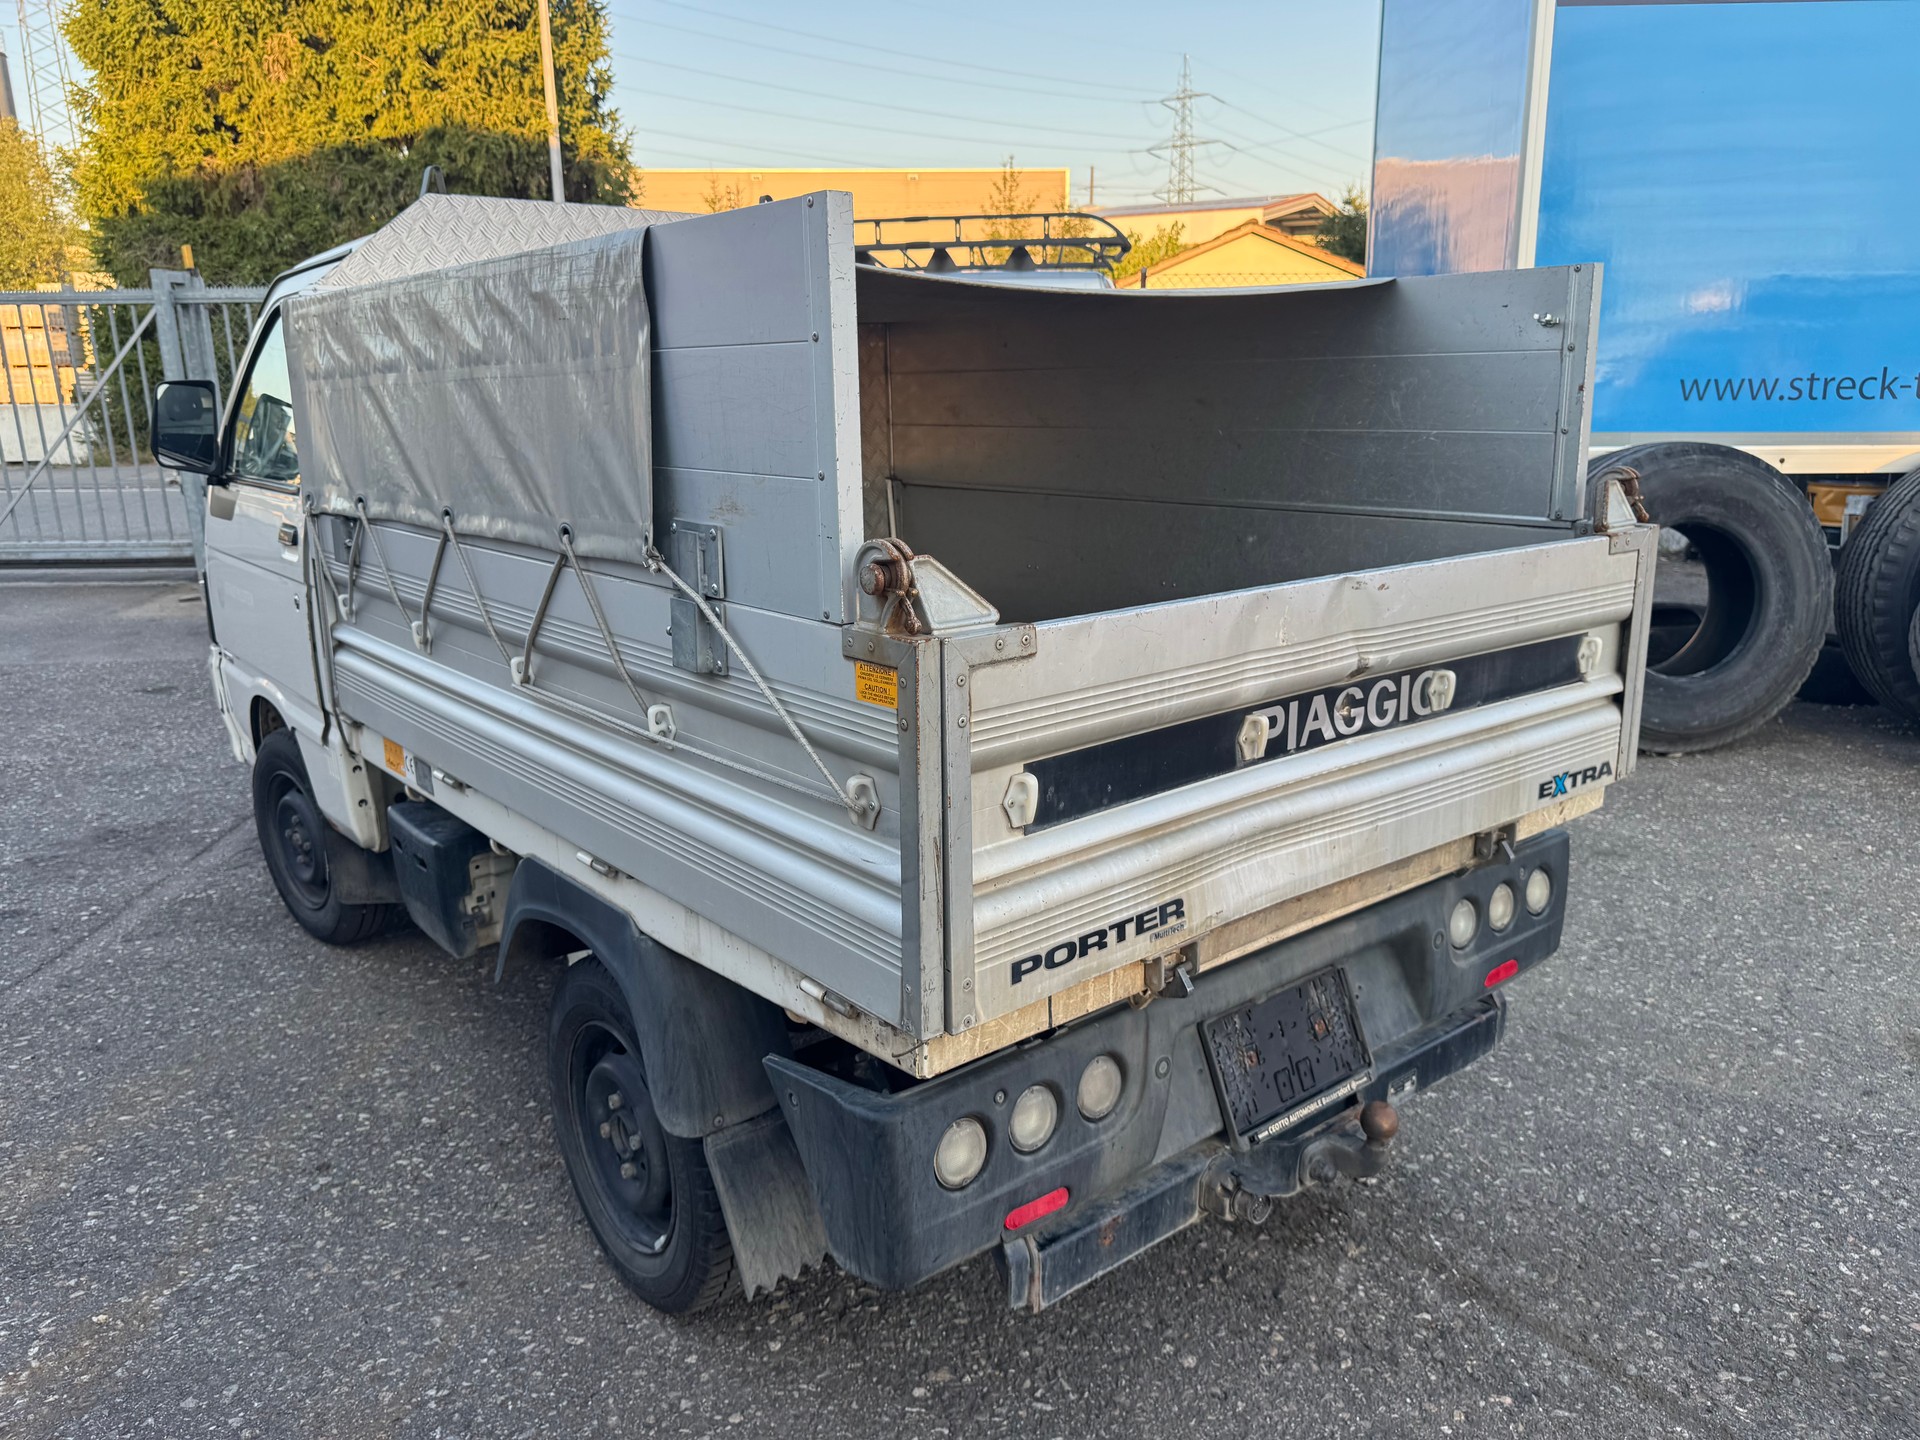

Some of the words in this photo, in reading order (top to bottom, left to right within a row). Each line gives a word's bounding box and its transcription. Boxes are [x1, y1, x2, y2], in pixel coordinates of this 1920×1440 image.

[1538, 760, 1613, 800] EXTRA
[1011, 898, 1185, 985] PORTER
[1268, 1117, 1290, 1134] CEOTTO
[1289, 1098, 1322, 1122] AUTOMOBILE
